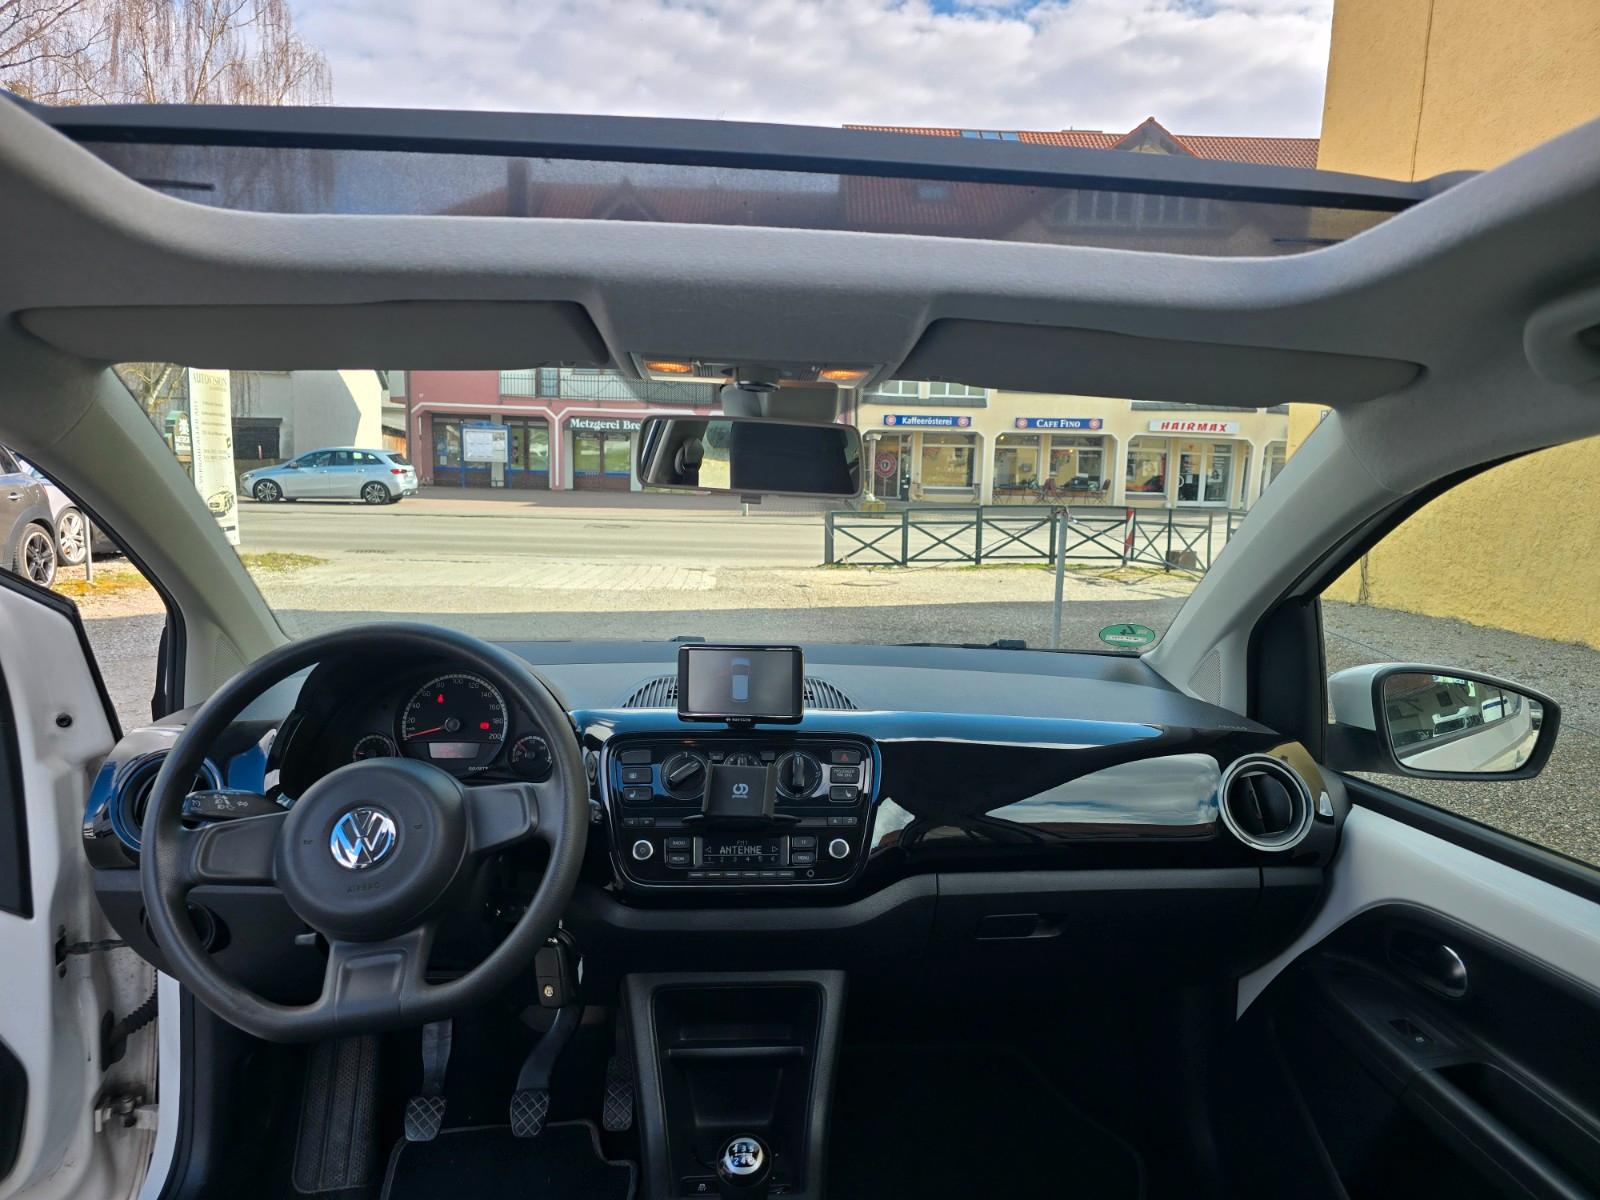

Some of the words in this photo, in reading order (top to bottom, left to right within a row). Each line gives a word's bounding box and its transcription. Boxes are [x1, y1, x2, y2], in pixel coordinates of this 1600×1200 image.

[570, 418, 620, 431] Metzgerei
[902, 417, 953, 426] Kaffeerösterei
[1161, 422, 1227, 432] HAIRMAX
[719, 845, 762, 855] ANTENNE
